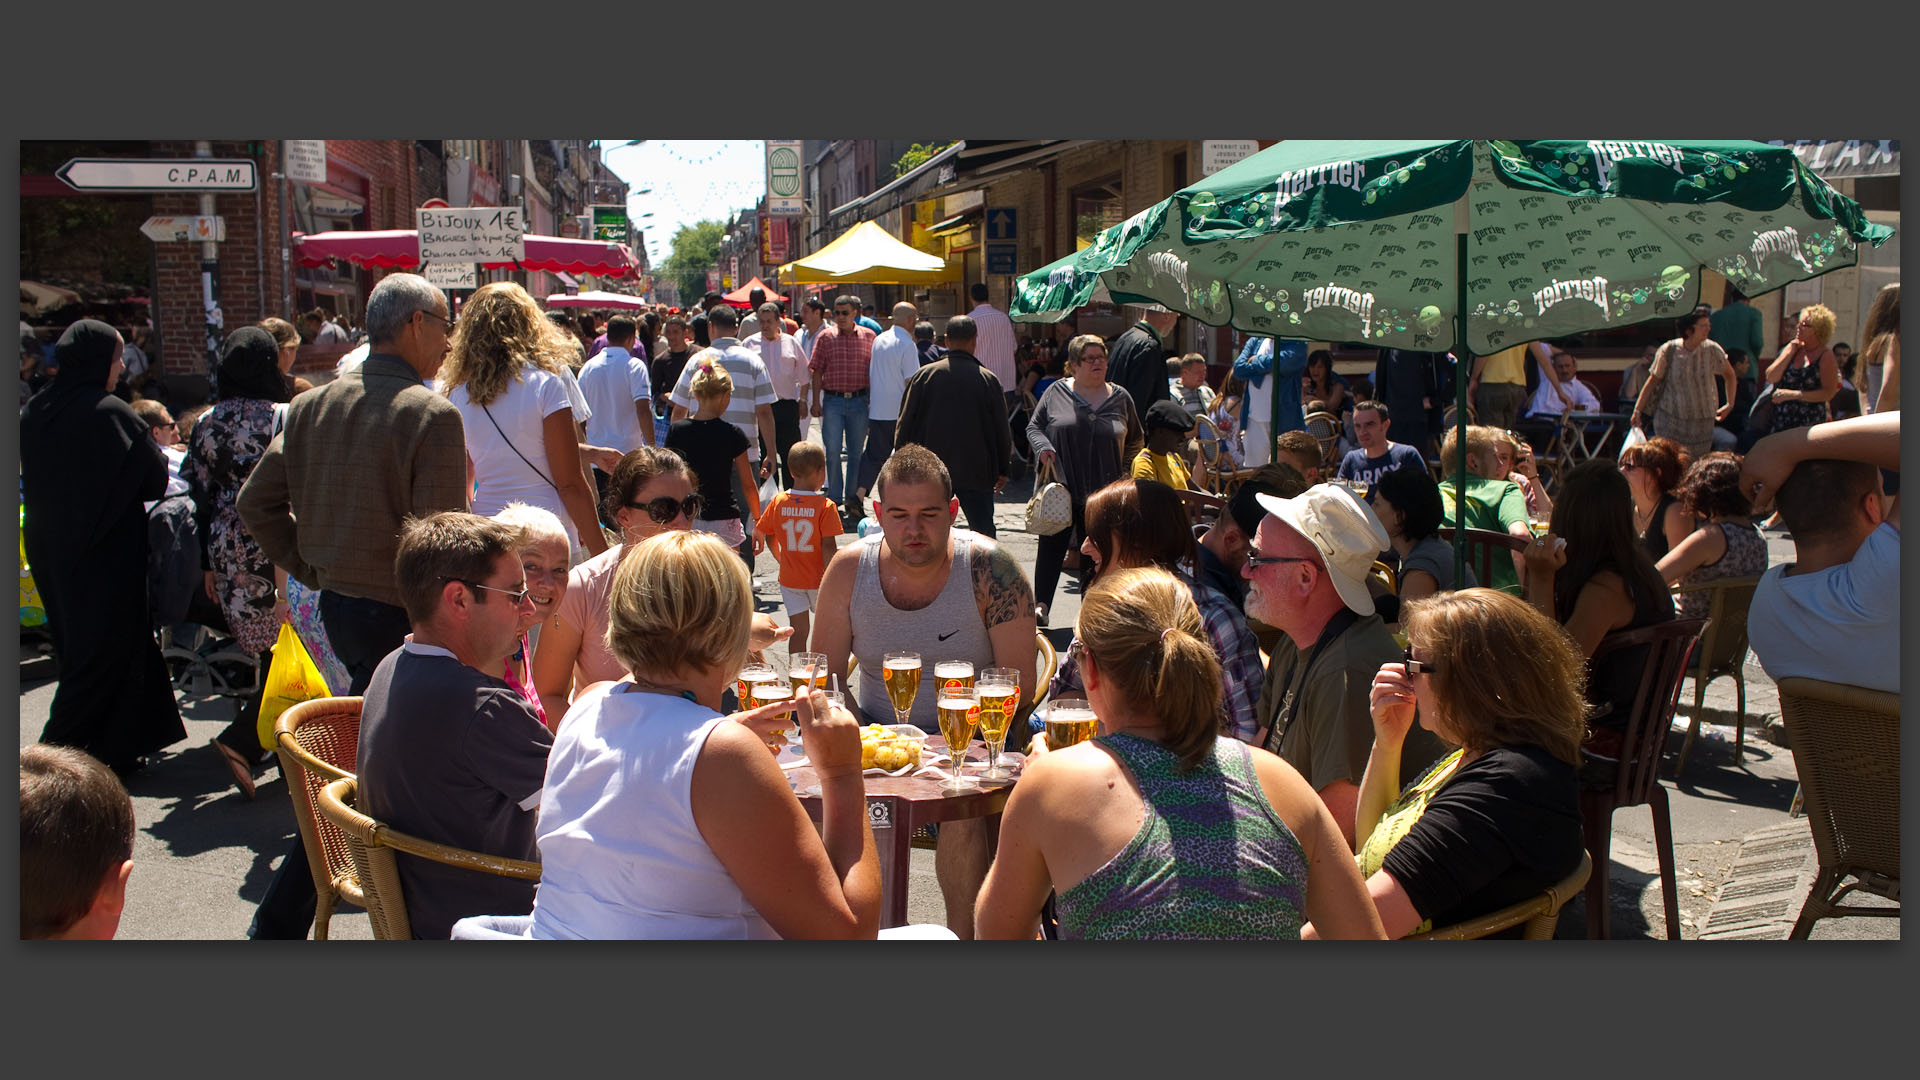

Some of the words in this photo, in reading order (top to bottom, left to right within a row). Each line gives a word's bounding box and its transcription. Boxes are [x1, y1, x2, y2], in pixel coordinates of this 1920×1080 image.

[168, 168, 246, 183] C.P.A.M.
[489, 211, 519, 231] 1€
[505, 235, 521, 243] 5€
[496, 247, 514, 257] 1€
[460, 273, 475, 285] 1€
[781, 507, 815, 517] HOLLAND
[781, 519, 814, 552] 12
